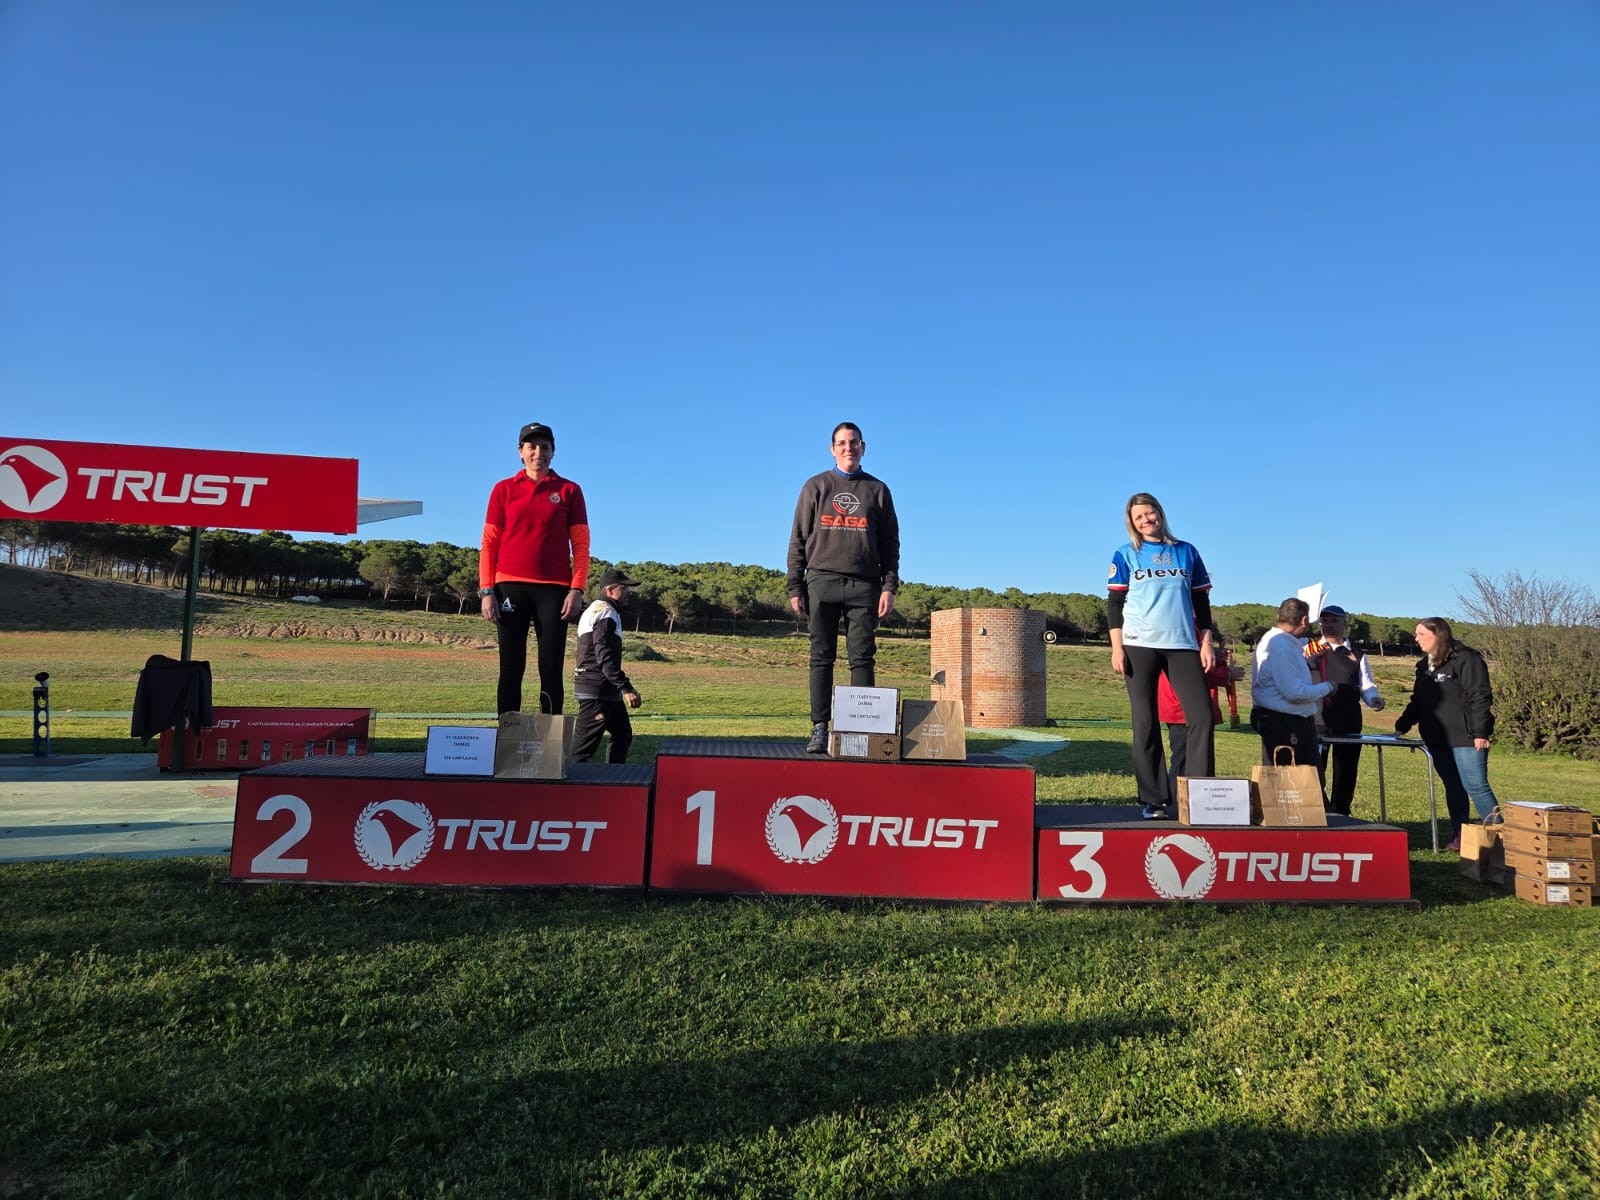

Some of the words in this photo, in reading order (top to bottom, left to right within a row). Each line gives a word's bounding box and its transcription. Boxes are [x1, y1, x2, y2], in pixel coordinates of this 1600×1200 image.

[77, 467, 269, 507] TRUST
[821, 515, 868, 528] SAGA
[250, 794, 312, 874] 2
[437, 818, 608, 852] TRUST
[686, 790, 716, 866] 1
[840, 814, 999, 850] TRUST
[1058, 830, 1107, 901] 3
[1217, 851, 1374, 883] TRUST
